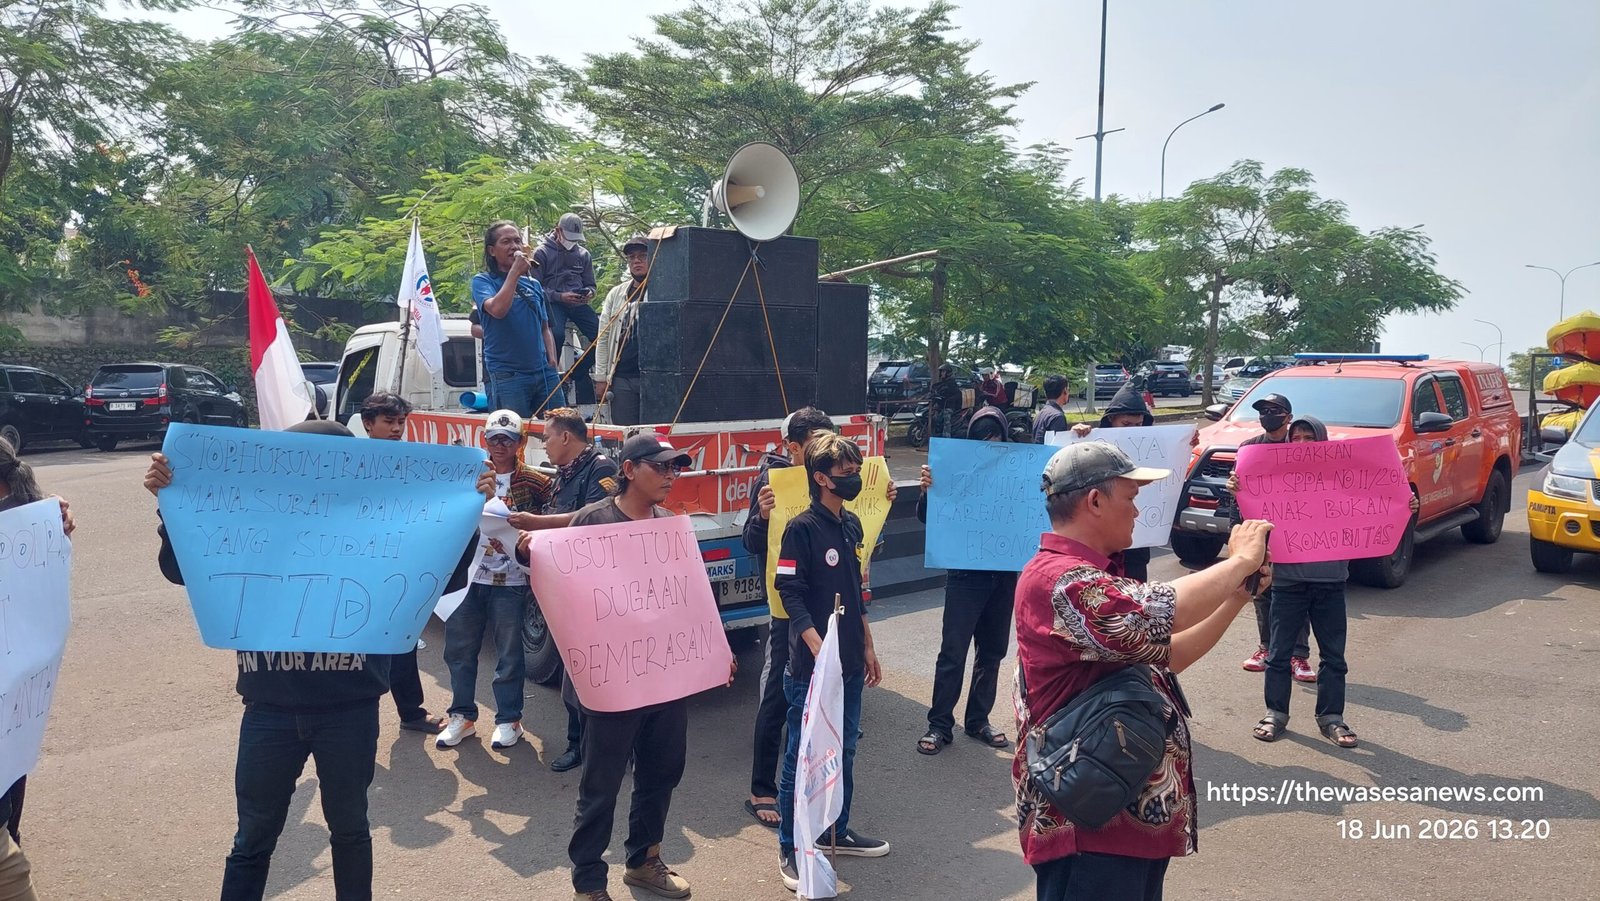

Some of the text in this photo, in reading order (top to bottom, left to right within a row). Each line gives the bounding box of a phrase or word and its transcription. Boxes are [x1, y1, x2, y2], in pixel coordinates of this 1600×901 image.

[972, 442, 1039, 482] STOP
[1269, 444, 1353, 464] TEGAKKAN
[178, 484, 447, 524] MANA SURAT DAMAI
[935, 501, 1018, 525] KARENA
[1260, 496, 1392, 522] ANAK BUKAN
[196, 524, 407, 560] YANG SUDAH
[548, 533, 619, 575] USUT
[1283, 523, 1394, 554] KOMODITAS
[593, 574, 688, 622] DUGAAN
[721, 577, 761, 596] B 9184
[566, 620, 714, 688] PEMERASAN
